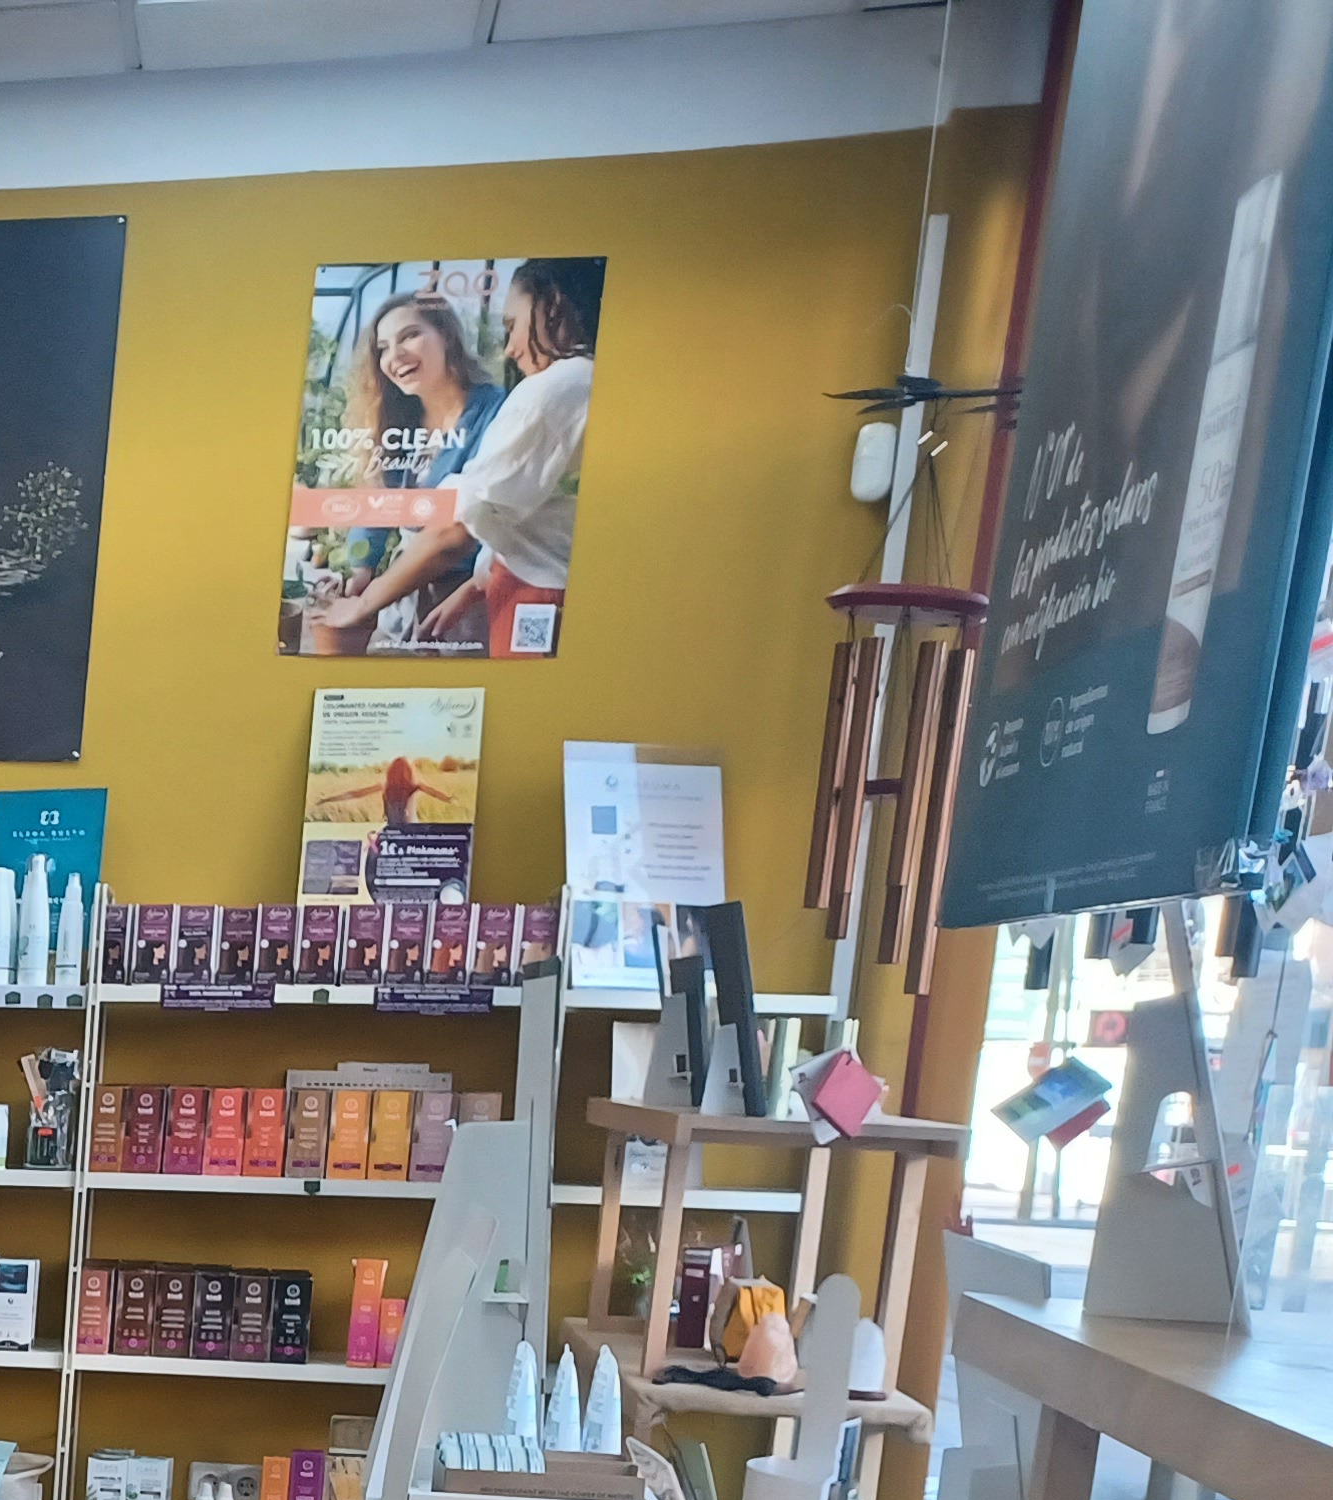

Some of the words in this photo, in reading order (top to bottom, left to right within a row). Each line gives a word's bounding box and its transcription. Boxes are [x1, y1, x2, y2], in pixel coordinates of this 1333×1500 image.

[310, 427, 374, 450] 100%
[381, 427, 467, 449] CLEAN
[364, 446, 432, 480] Beauty
